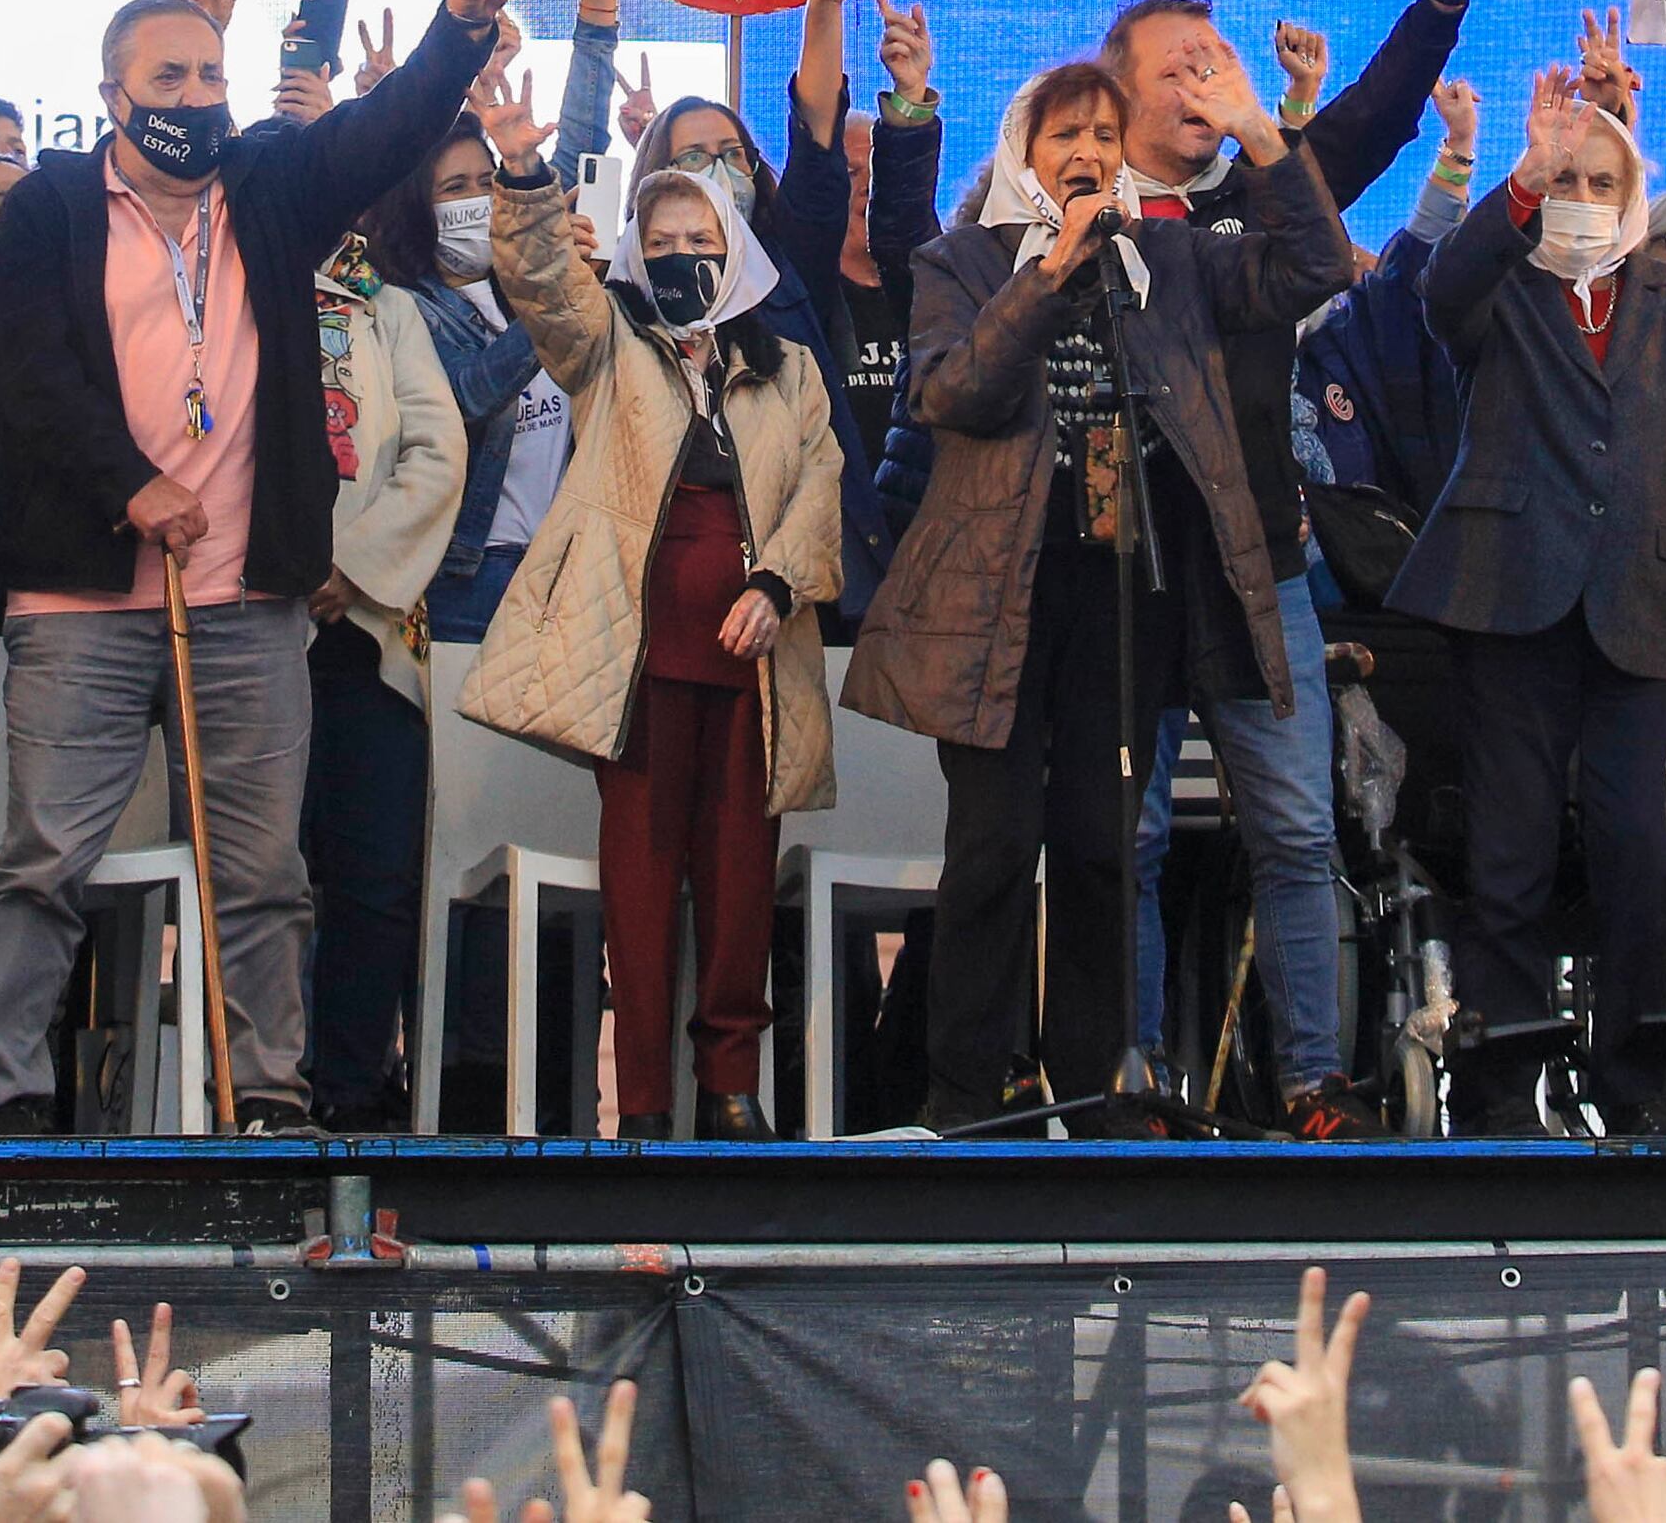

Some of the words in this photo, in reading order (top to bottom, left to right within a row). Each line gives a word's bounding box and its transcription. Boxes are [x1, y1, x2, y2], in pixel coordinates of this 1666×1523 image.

[148, 114, 188, 139] DÓNDE
[143, 134, 191, 163] ESTÁN?
[443, 206, 491, 227] NUNCA
[848, 373, 867, 386] DE
